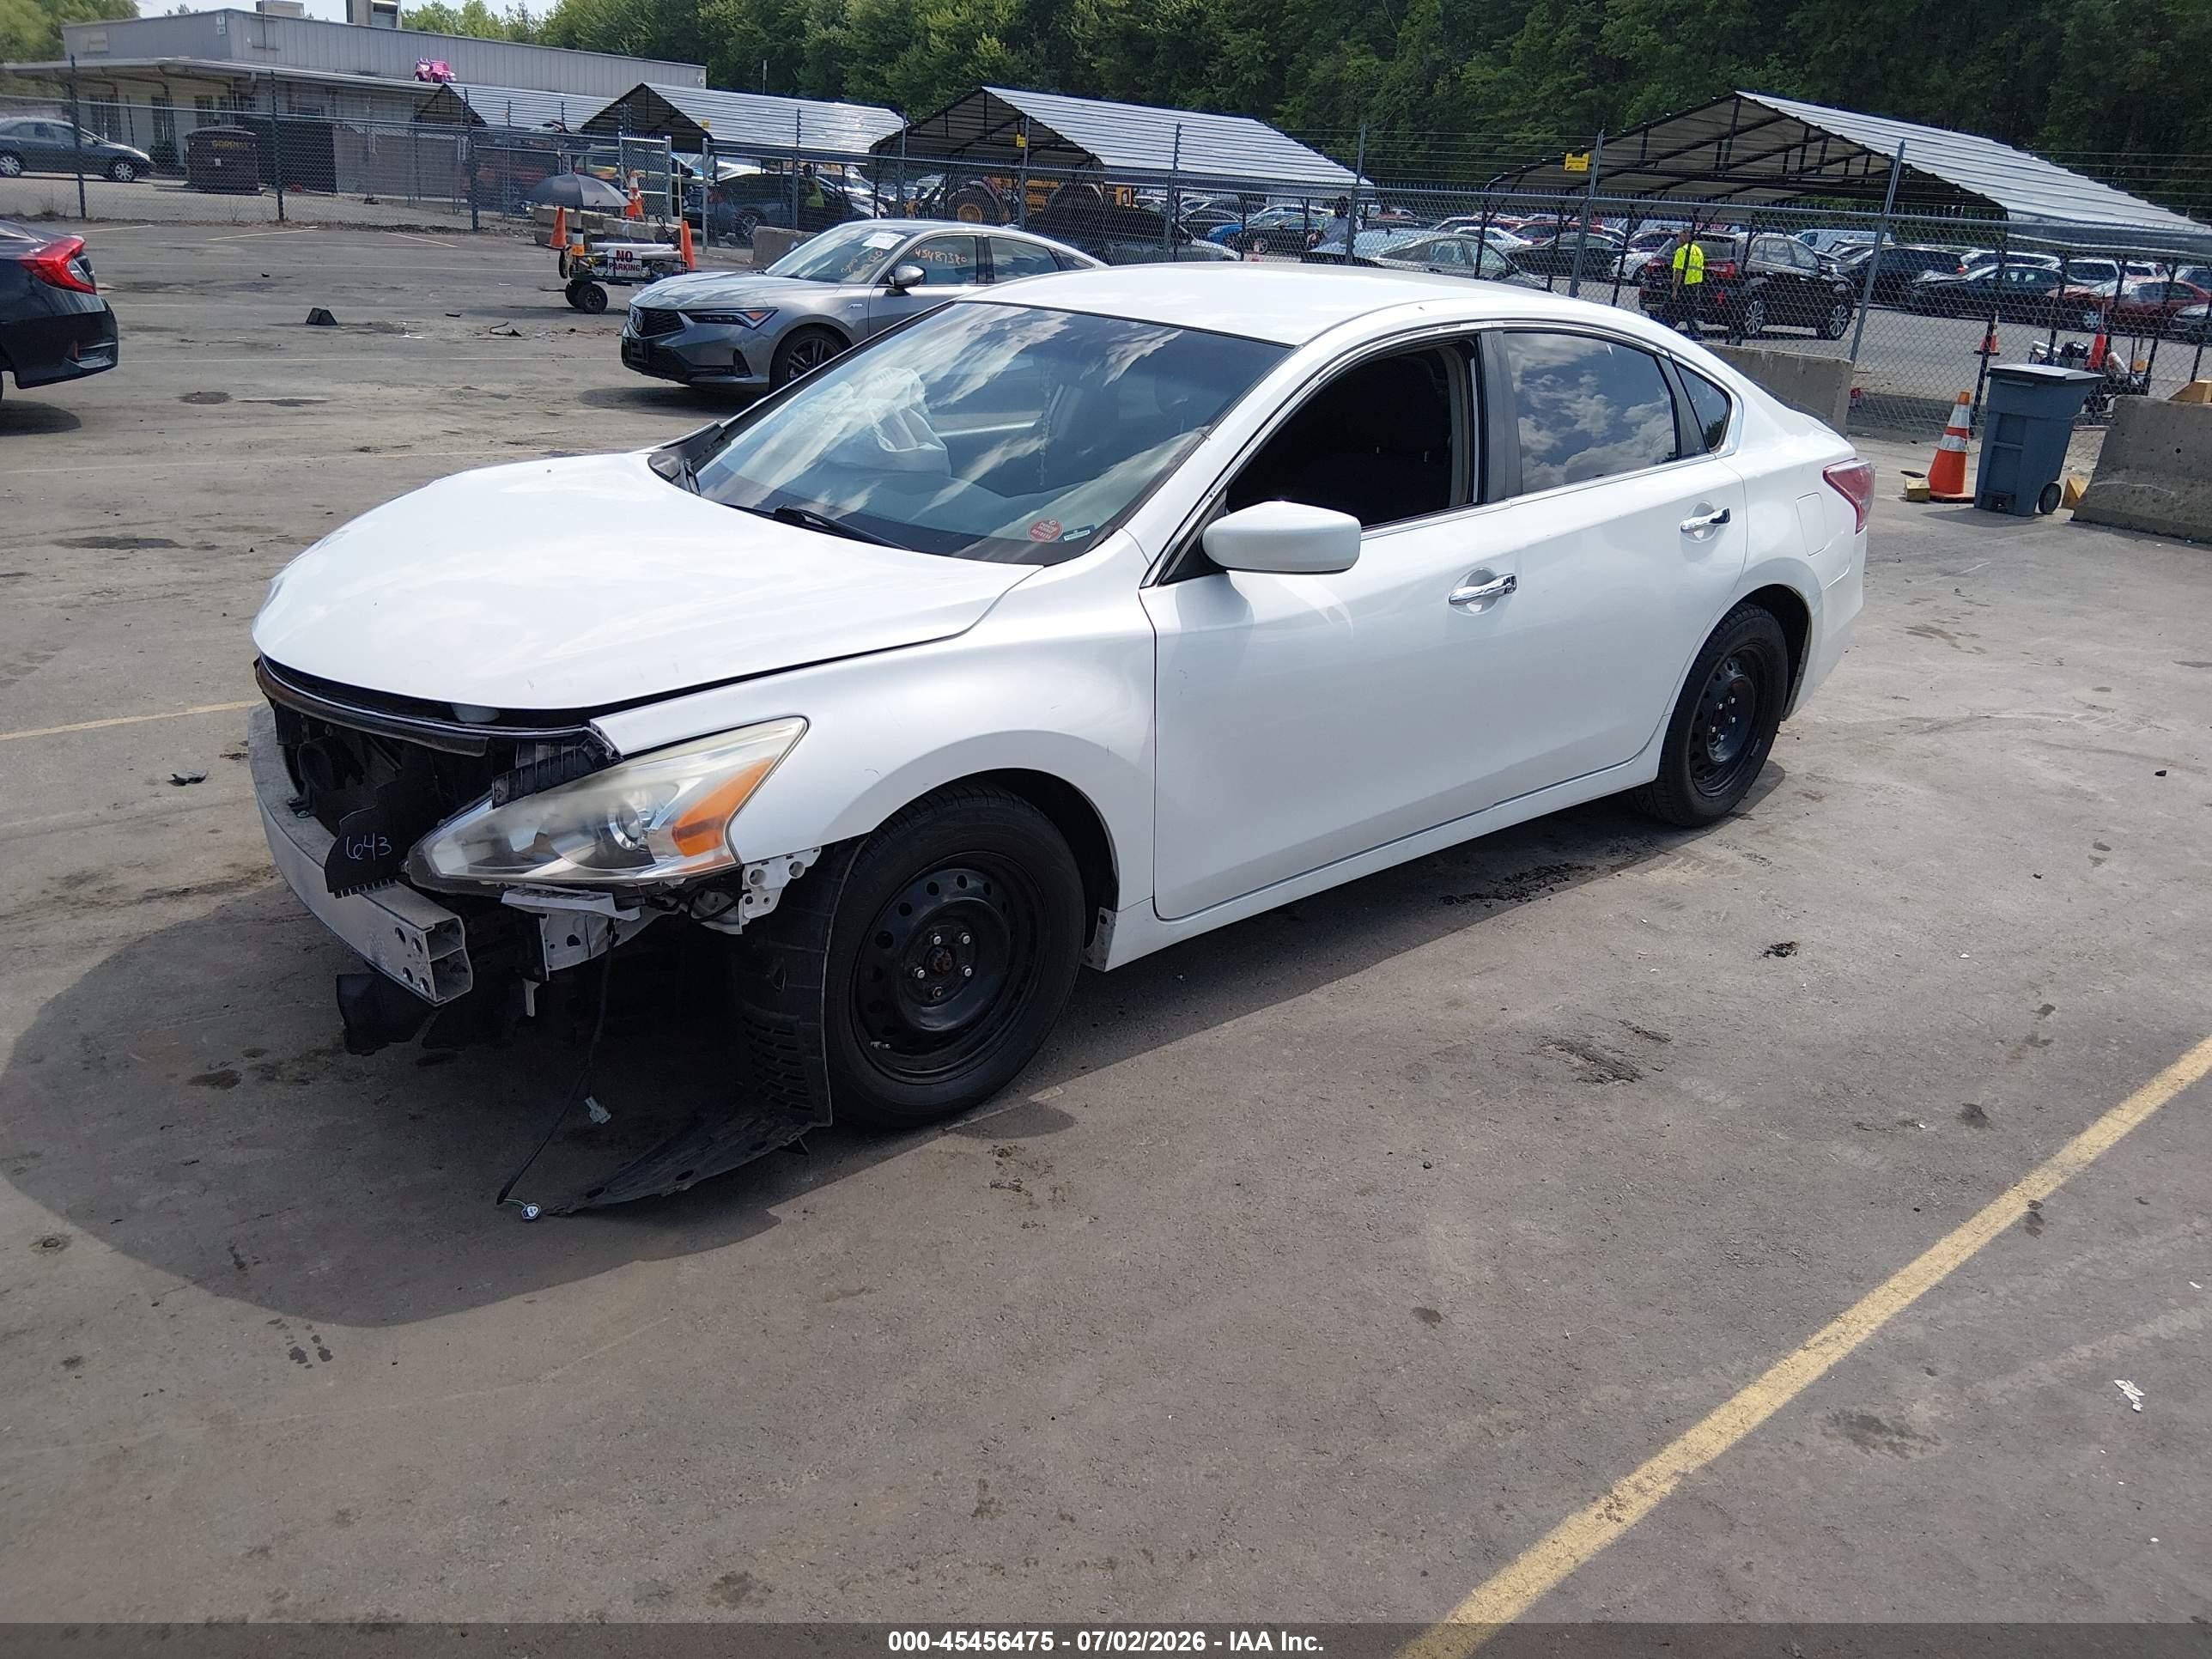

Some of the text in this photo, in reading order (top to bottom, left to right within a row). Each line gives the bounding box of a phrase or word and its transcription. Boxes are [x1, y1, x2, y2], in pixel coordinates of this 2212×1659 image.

[616, 249, 634, 263] NO
[609, 262, 641, 272] PARKING
[346, 832, 392, 861] 643
